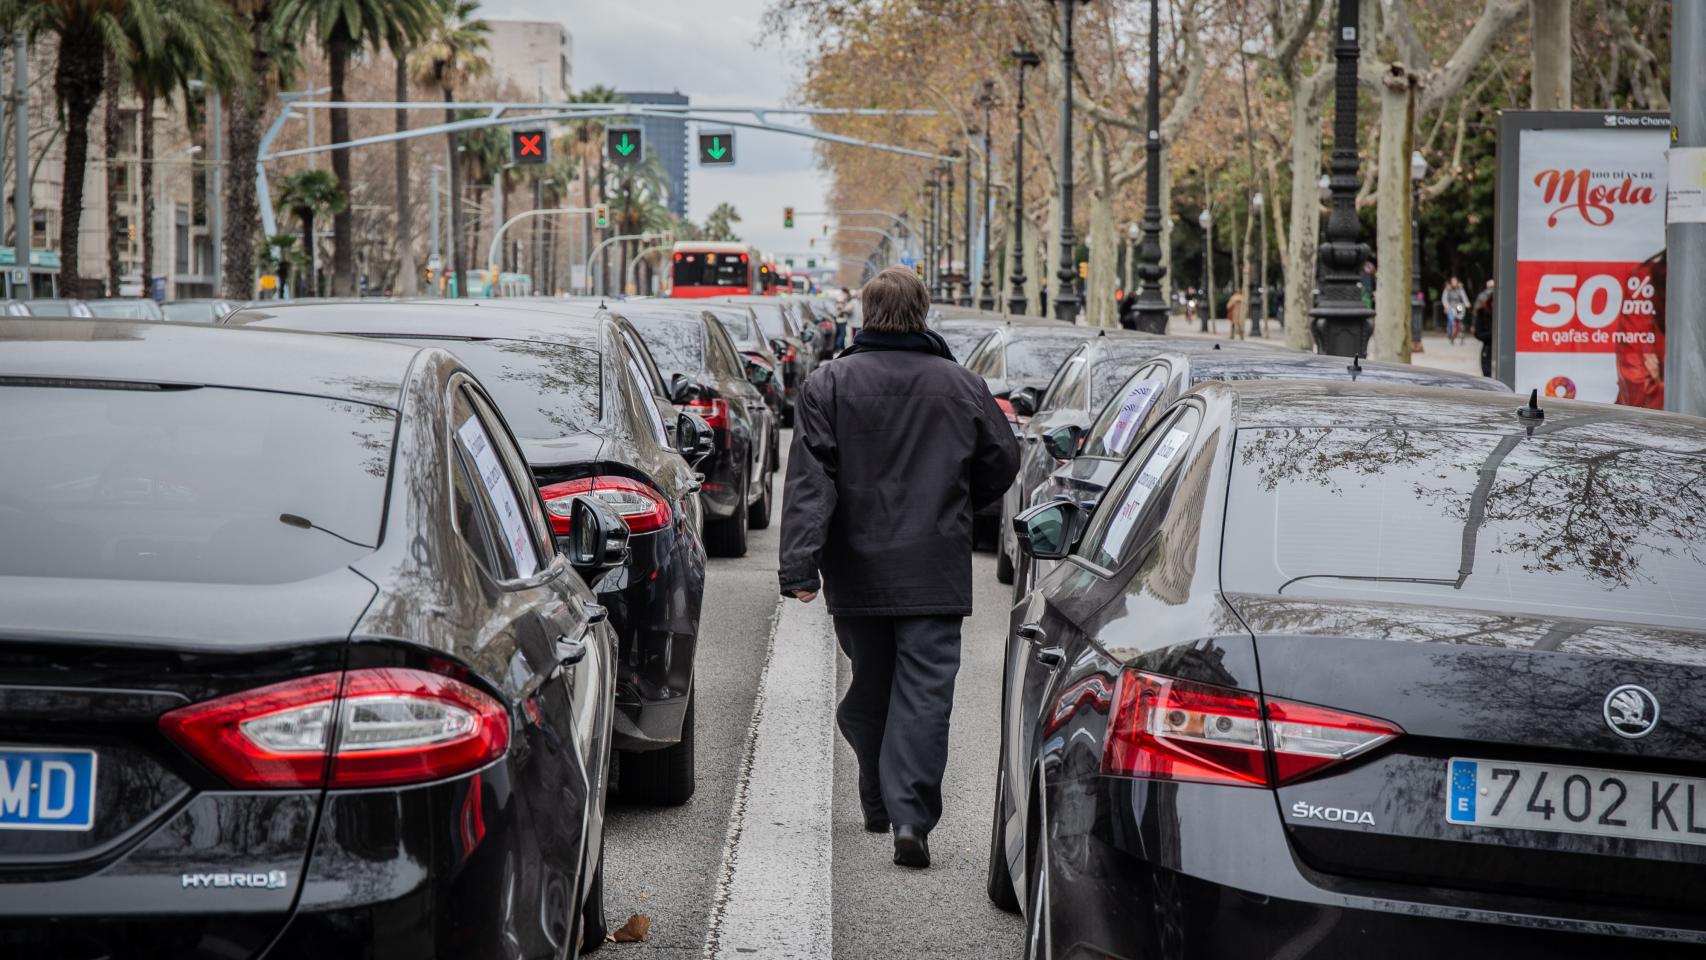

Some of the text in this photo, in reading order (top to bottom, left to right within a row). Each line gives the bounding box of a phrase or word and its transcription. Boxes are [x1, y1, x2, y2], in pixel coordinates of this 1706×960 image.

[1617, 116, 1639, 125] Clear
[1592, 171, 1610, 179] 100
[1641, 171, 1655, 179] DE
[1534, 168, 1658, 228] Moda
[1622, 301, 1656, 315] DTO.
[1532, 329, 1656, 345] en gafas de marca
[1457, 796, 1469, 811] E
[1490, 767, 1628, 828] 7402
[1290, 801, 1376, 826] ŠKODA
[181, 872, 268, 888] HYBRID
